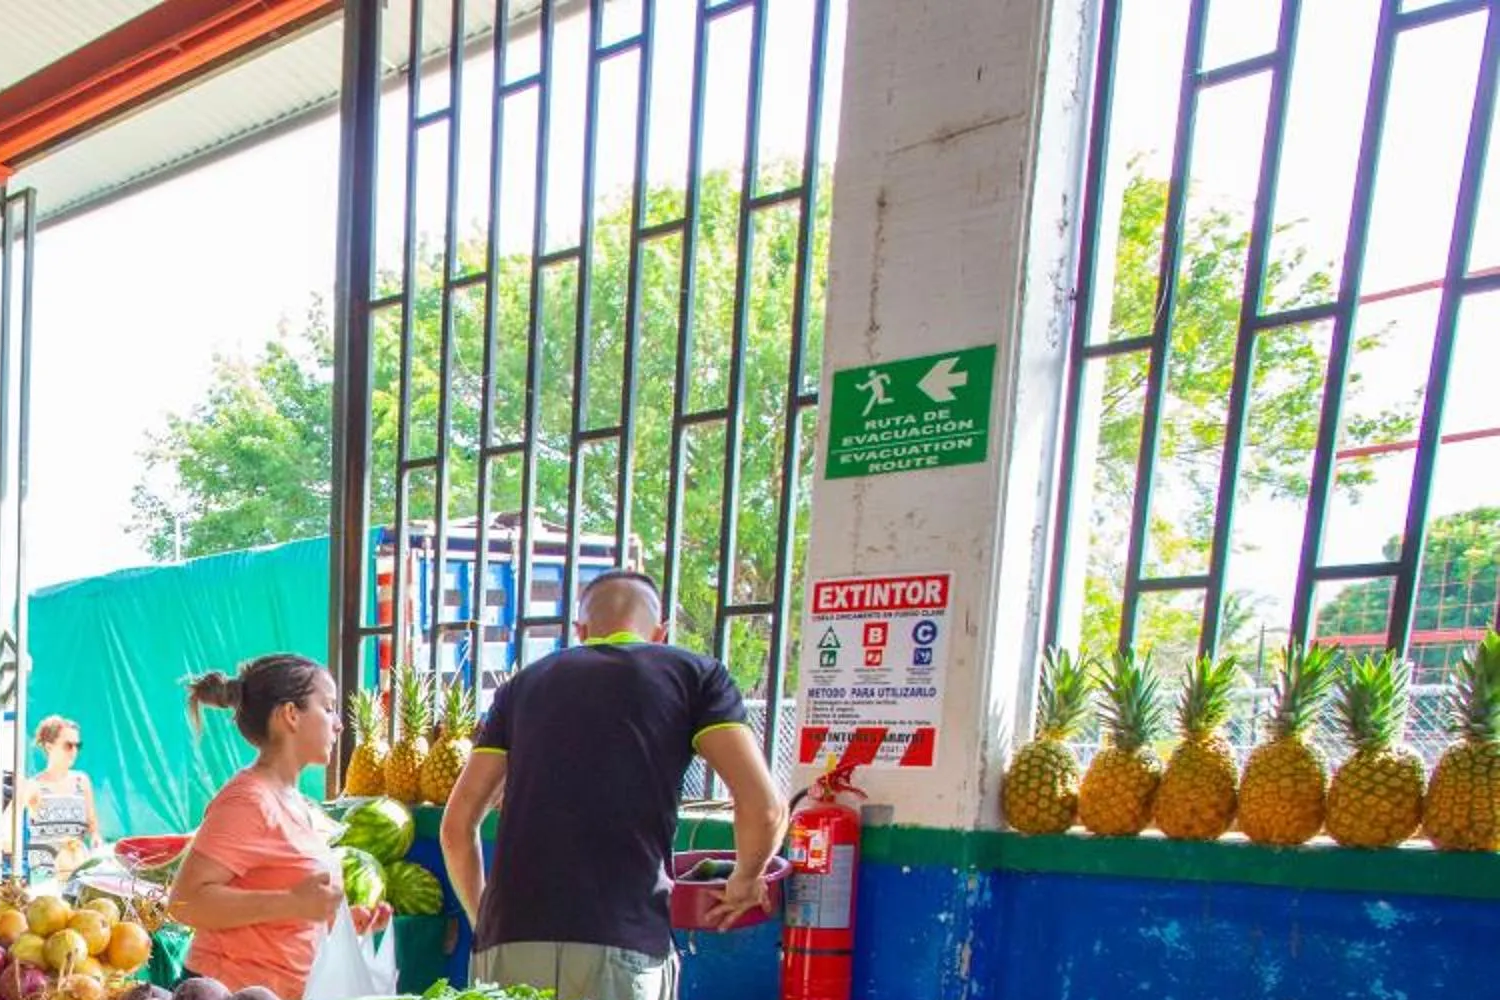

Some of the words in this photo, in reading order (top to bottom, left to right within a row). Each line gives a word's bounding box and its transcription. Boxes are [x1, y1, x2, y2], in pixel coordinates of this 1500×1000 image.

[864, 414, 916, 430] RUTA
[924, 409, 950, 421] DE
[840, 437, 973, 464] EVACUATION
[868, 455, 939, 473] ROUTE
[818, 580, 942, 609] EXTINTOR
[868, 627, 883, 644] B
[916, 624, 934, 642] C
[851, 688, 875, 698] PARA
[877, 687, 937, 698] UTILIZARLO
